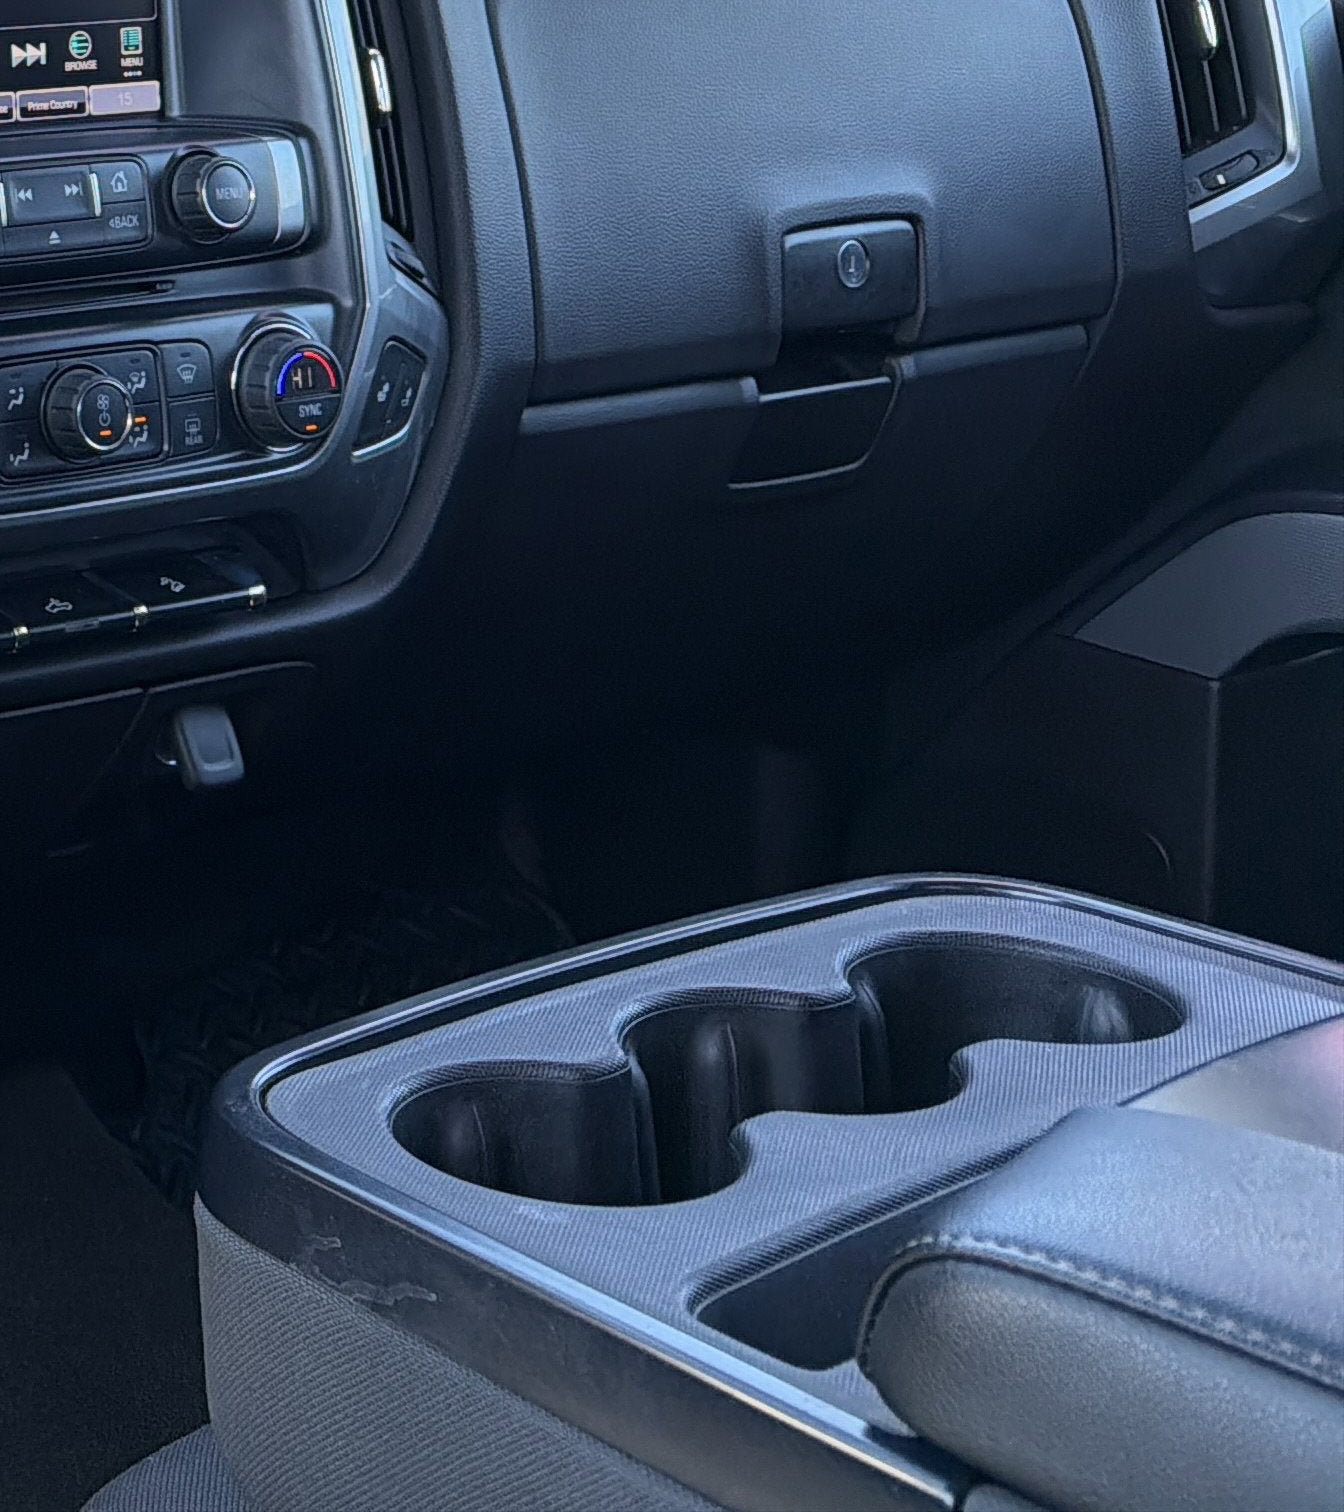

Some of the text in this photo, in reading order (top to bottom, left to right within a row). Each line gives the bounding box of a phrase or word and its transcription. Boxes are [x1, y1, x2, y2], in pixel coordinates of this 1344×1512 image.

[64, 60, 98, 72] BROWSE
[121, 57, 144, 67] MENU
[117, 92, 133, 106] 15
[116, 215, 139, 229] BACK
[291, 366, 313, 389] HI
[298, 403, 322, 418] SYNC
